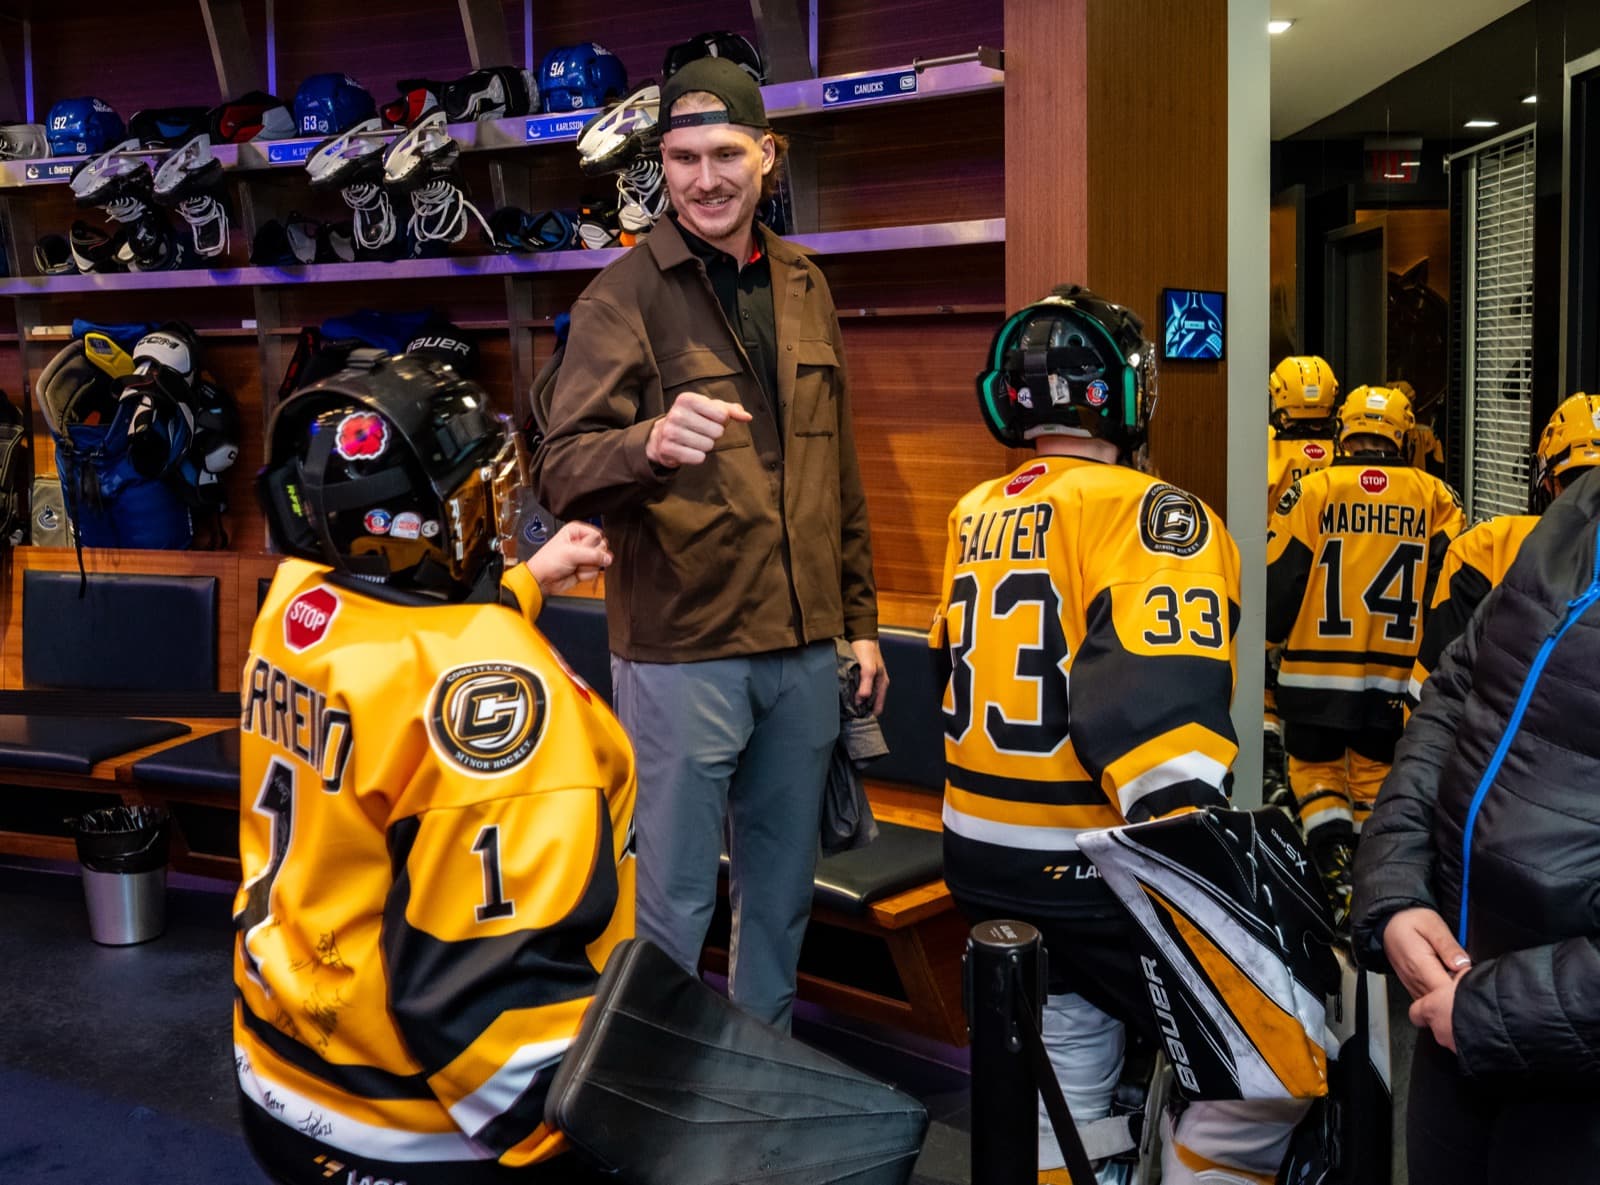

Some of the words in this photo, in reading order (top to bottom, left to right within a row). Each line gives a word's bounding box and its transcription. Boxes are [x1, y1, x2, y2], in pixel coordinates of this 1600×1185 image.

[550, 62, 566, 81] 94
[854, 82, 884, 95] CANUCKS
[54, 116, 67, 130] 92
[303, 115, 317, 131] 63
[1362, 475, 1386, 486] STOP
[957, 502, 1054, 566] SALTER
[1318, 501, 1427, 540] MAGHERA
[1317, 537, 1426, 643] 14
[290, 601, 327, 632] STOP
[1143, 584, 1225, 650] 33
[942, 568, 1071, 757] 33
[454, 751, 490, 769] MINOR
[492, 740, 532, 769] HOCKEY
[470, 824, 516, 924] 1
[1075, 864, 1103, 880] LA
[1139, 954, 1201, 1094] BAUER
